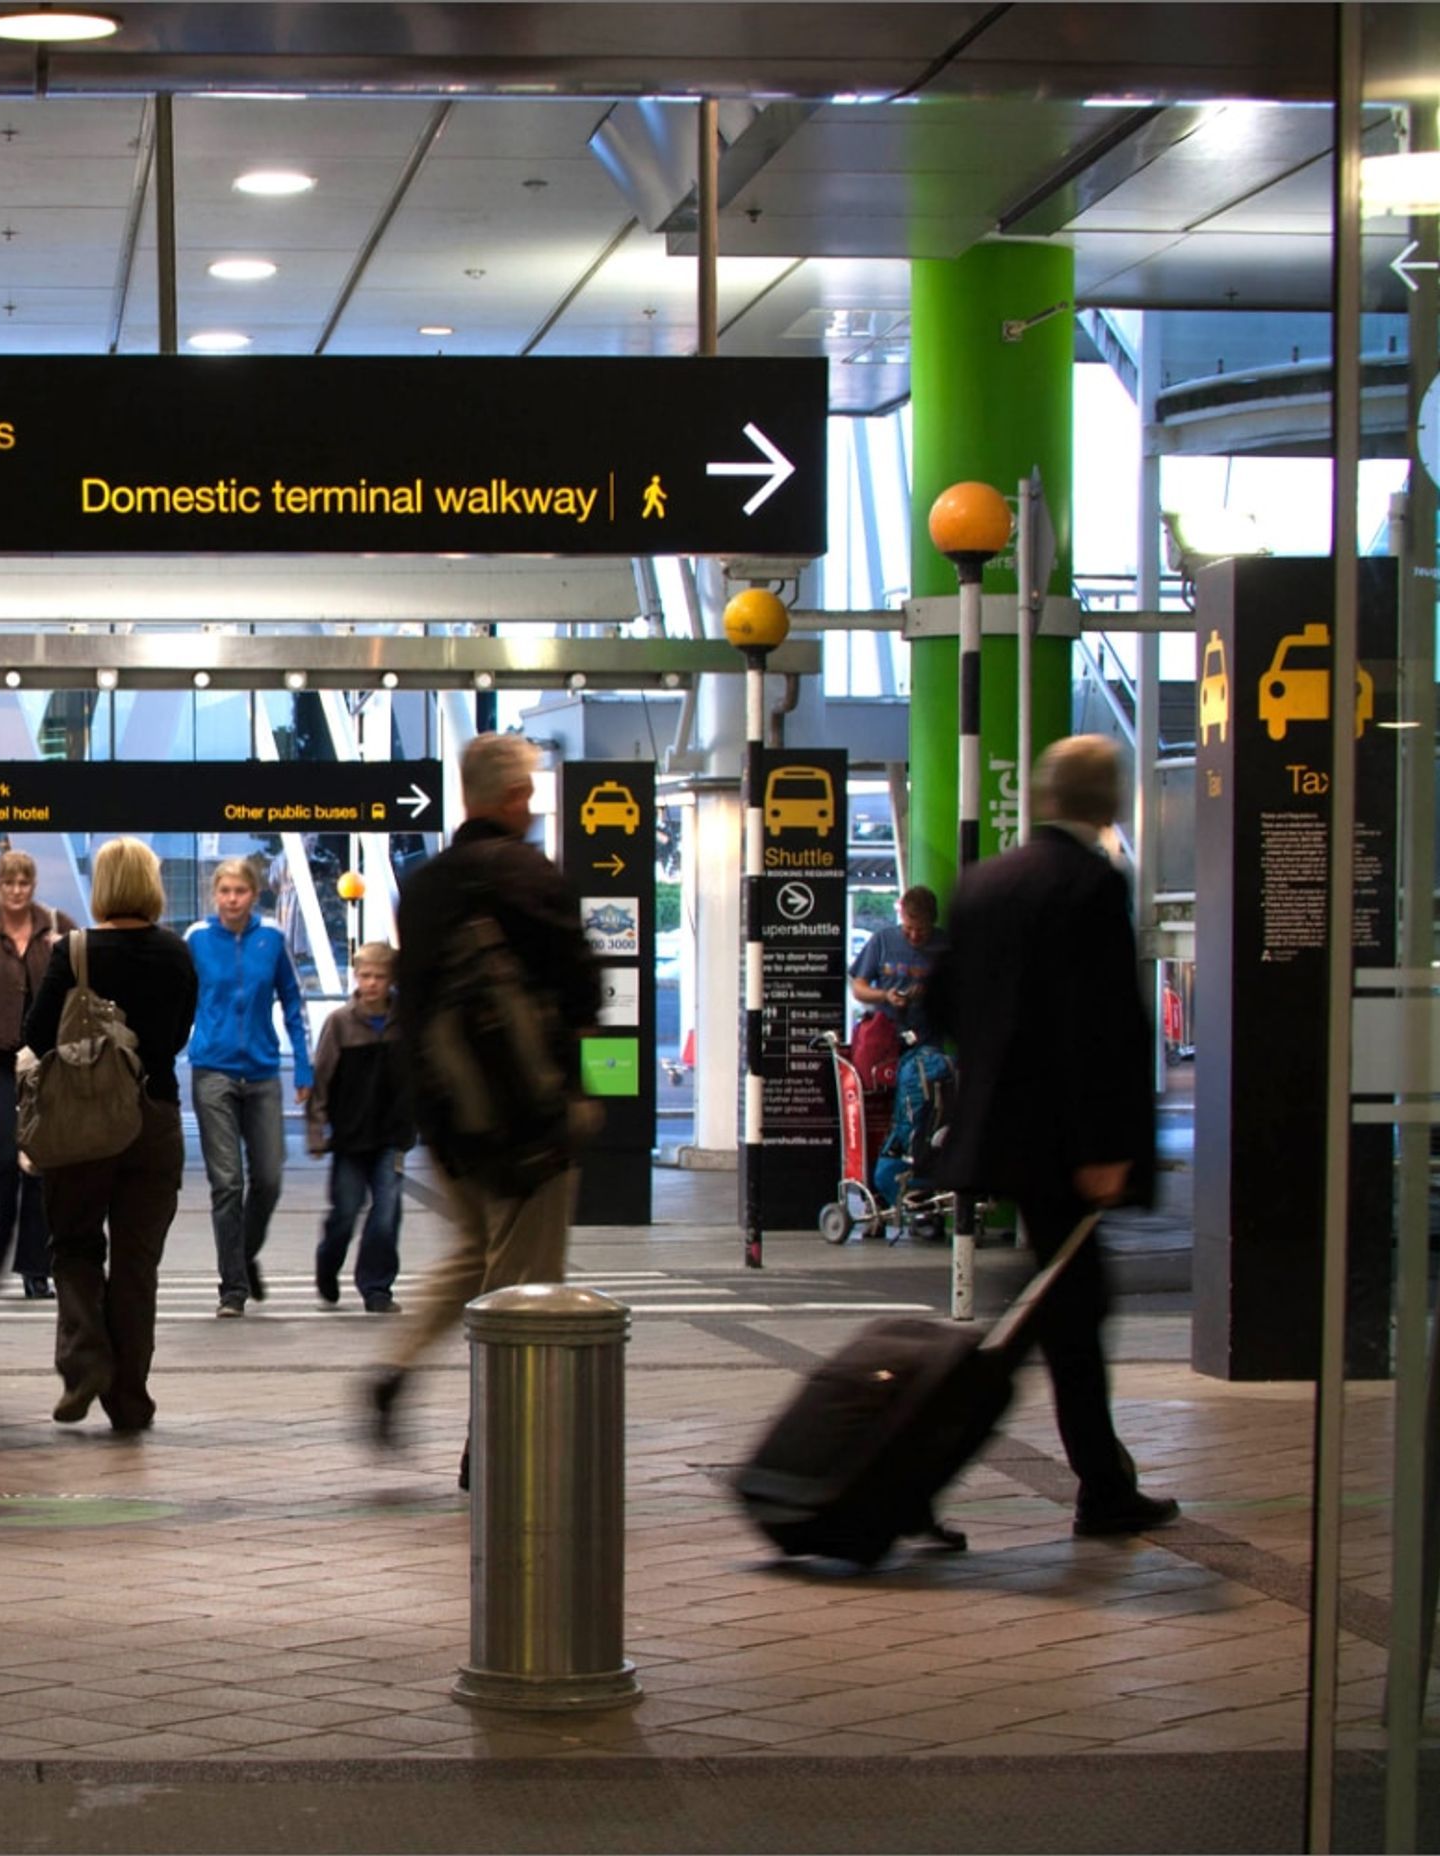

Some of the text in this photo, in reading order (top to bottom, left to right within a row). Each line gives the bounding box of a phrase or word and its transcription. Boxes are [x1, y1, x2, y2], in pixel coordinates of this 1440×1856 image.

[81, 477, 598, 523] Domestic terminal walkway
[12, 805, 50, 820] hotel
[224, 804, 358, 822] Other public buses
[765, 846, 834, 868] Shuttle
[762, 922, 841, 938] upershuttle
[607, 938, 636, 950] 3000
[763, 1137, 833, 1146] pershuttle.co.nz
